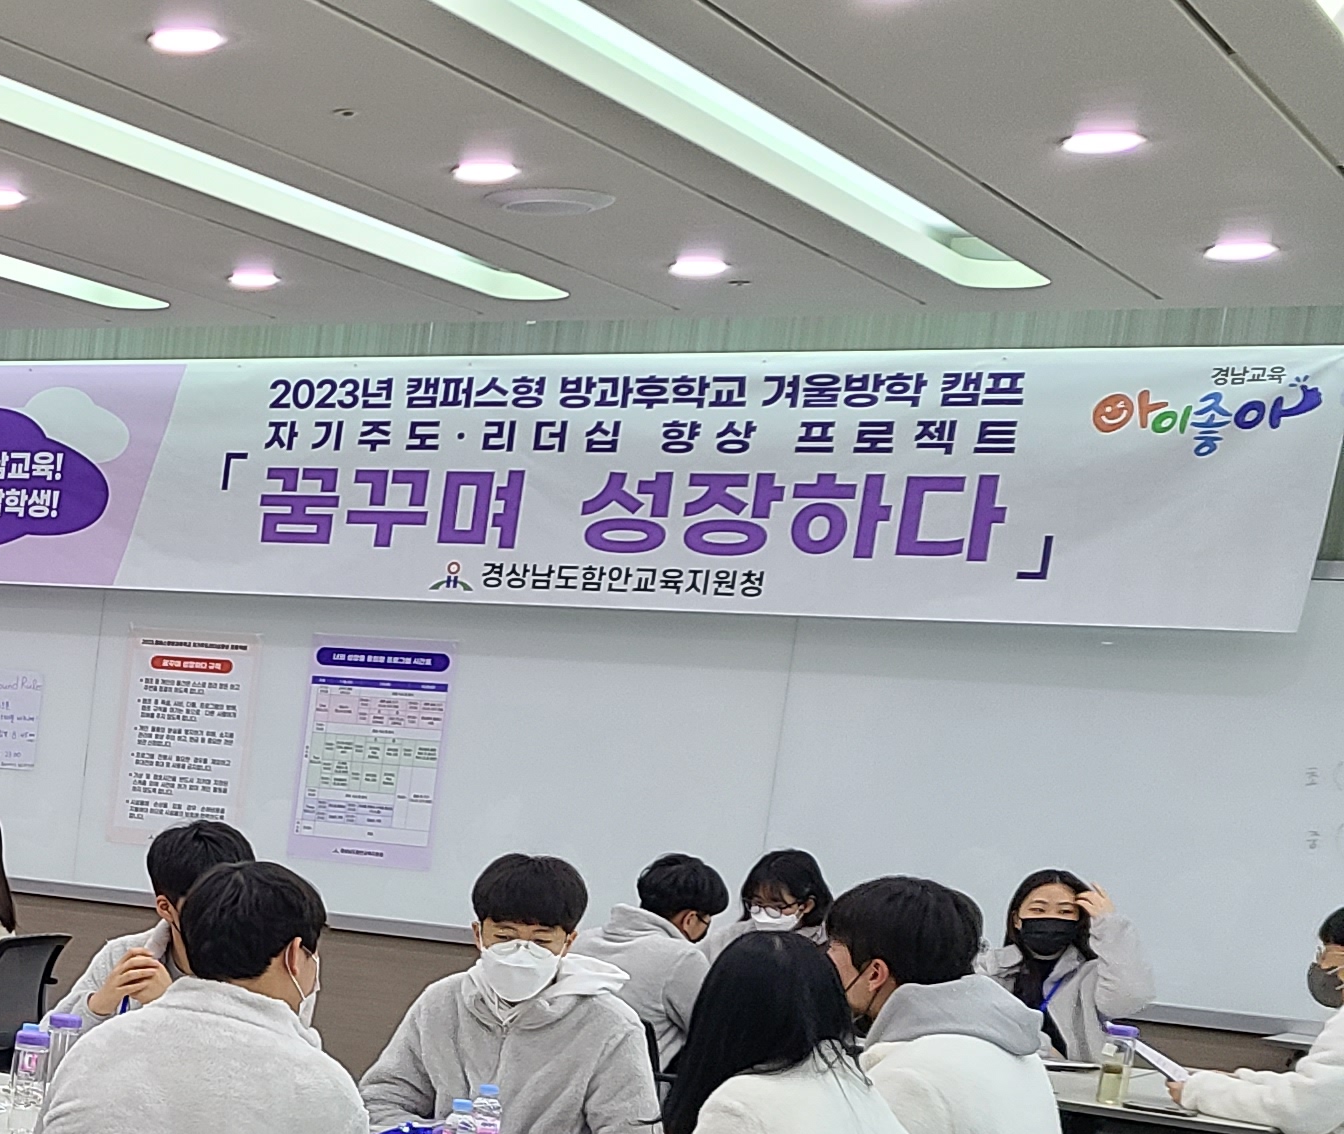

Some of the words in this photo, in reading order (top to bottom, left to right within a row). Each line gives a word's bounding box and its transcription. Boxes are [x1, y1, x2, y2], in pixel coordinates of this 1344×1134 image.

[268, 377, 394, 409] 2023년
[405, 376, 547, 409] 캠퍼스형
[559, 374, 747, 409] 방과후학교
[762, 373, 928, 408] 겨울방학
[941, 371, 1026, 407] 캠프
[1211, 366, 1286, 386] 경남교육
[481, 562, 765, 598] 경상남도함안교육지원청
